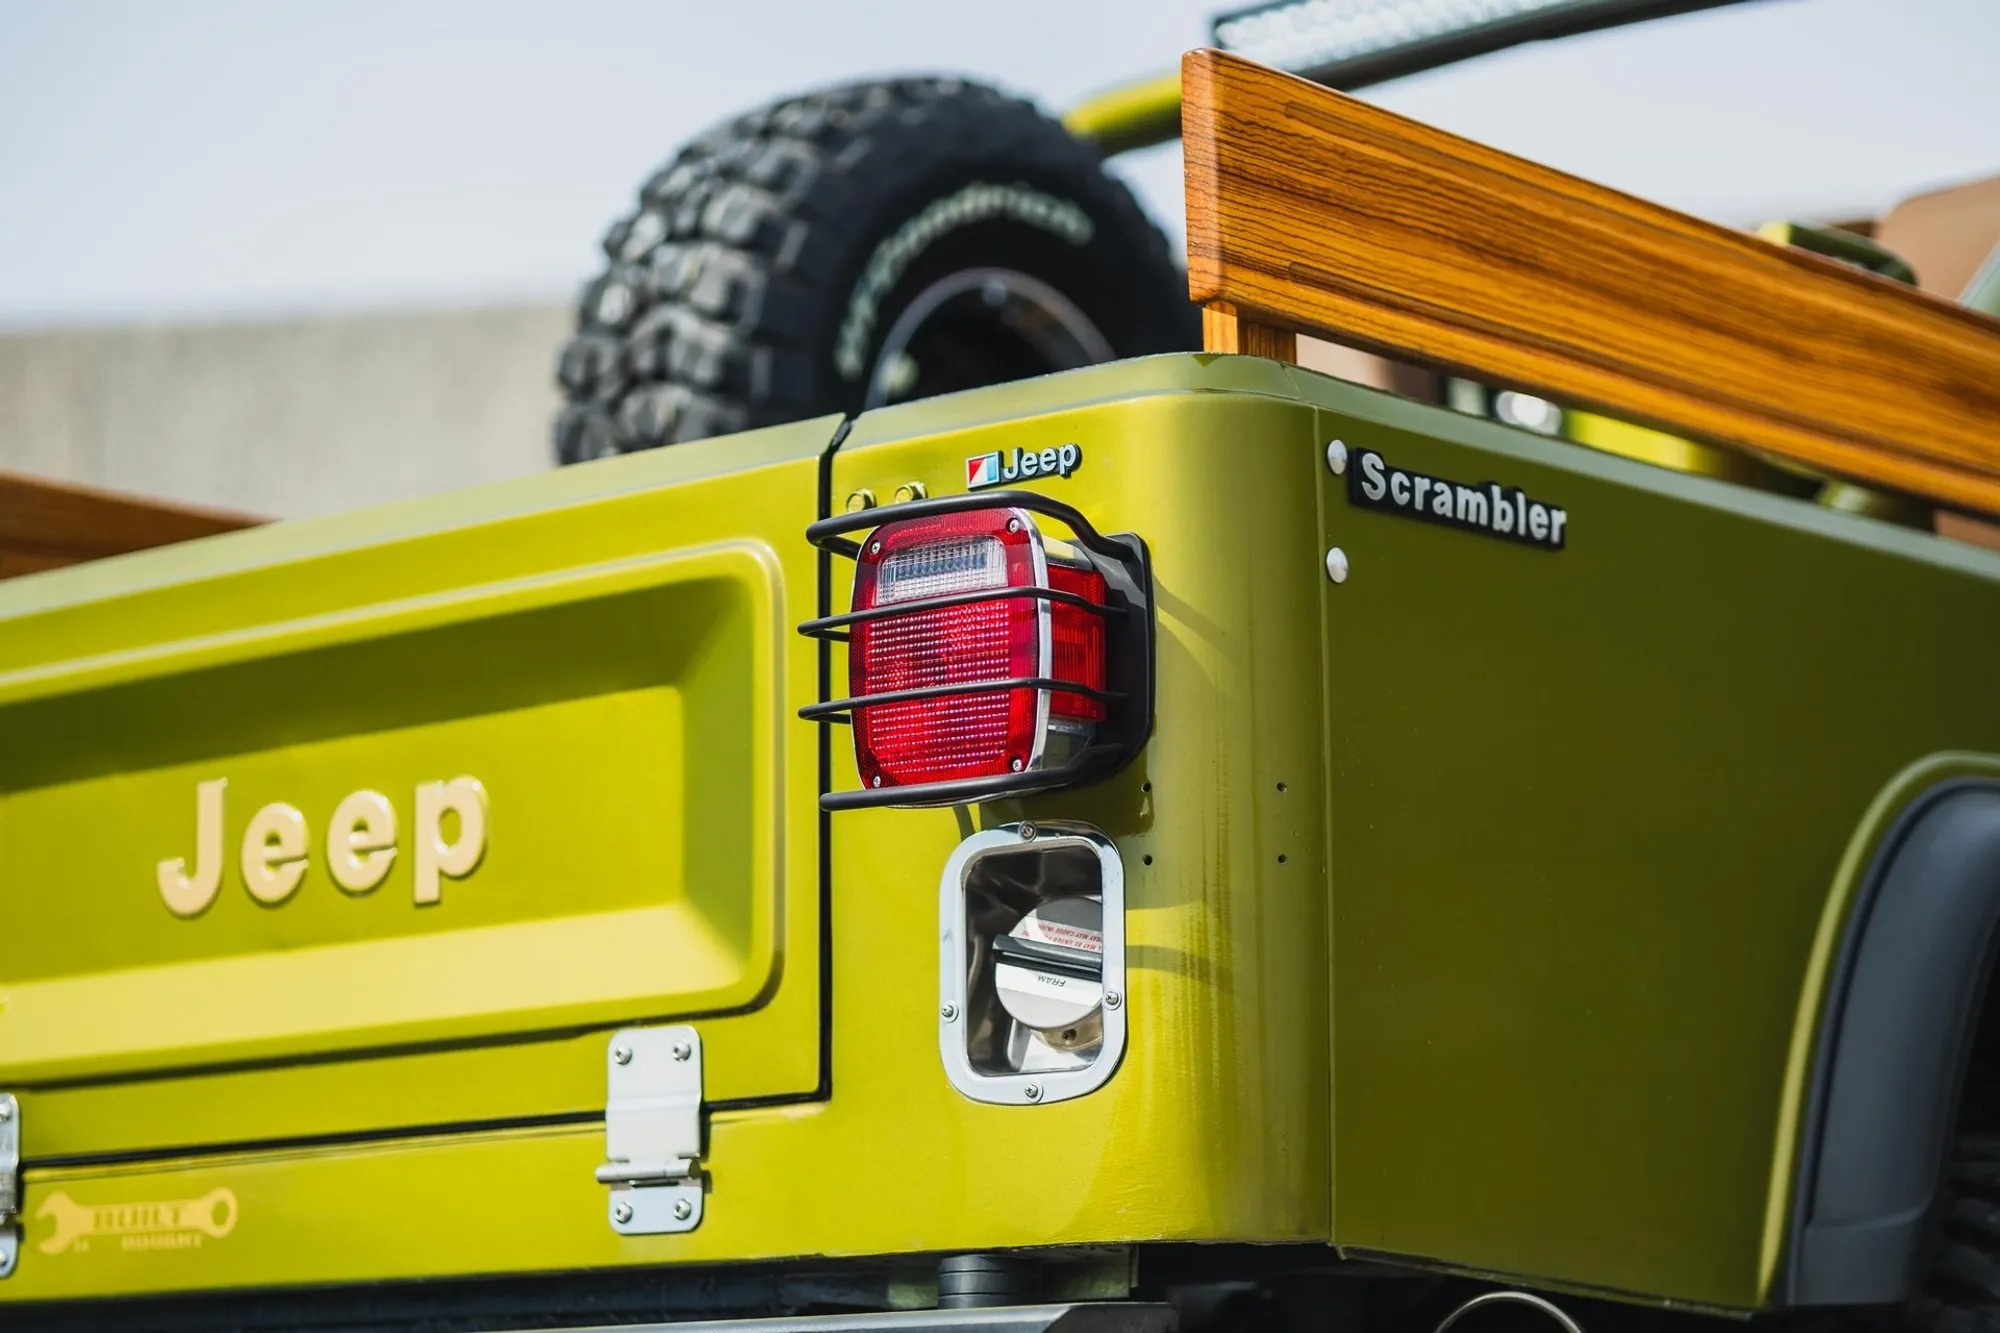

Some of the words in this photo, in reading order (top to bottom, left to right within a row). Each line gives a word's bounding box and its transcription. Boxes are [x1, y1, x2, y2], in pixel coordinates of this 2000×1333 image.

[1003, 442, 1079, 480] Jeep
[1361, 452, 1567, 544] Scrambler
[156, 775, 489, 920] Jeep
[1037, 975, 1066, 987] FRAM
